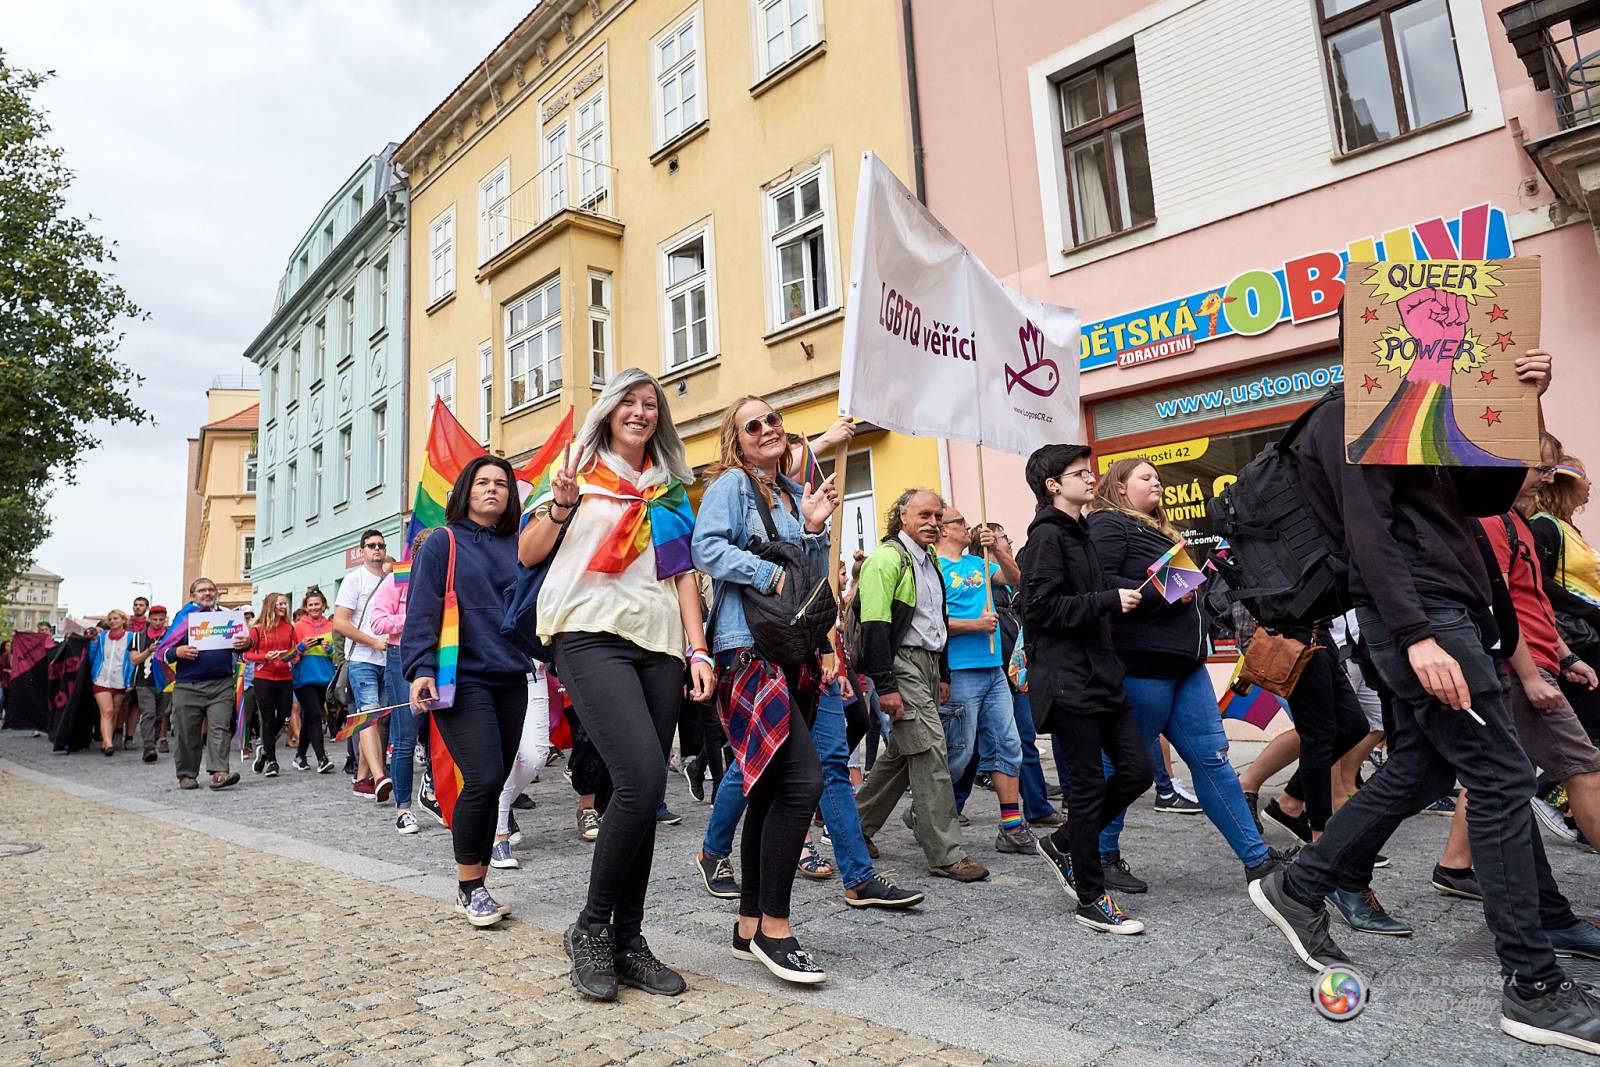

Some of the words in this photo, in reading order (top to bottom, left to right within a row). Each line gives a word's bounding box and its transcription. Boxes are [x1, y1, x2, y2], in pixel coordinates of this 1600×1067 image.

[1387, 263, 1477, 290] QUEER
[879, 281, 921, 348] LGBTQ
[923, 319, 977, 362] věřící
[1119, 334, 1182, 366] ZDRAVOTNÍ
[1384, 336, 1476, 363] POWER
[1175, 447, 1191, 457] 42
